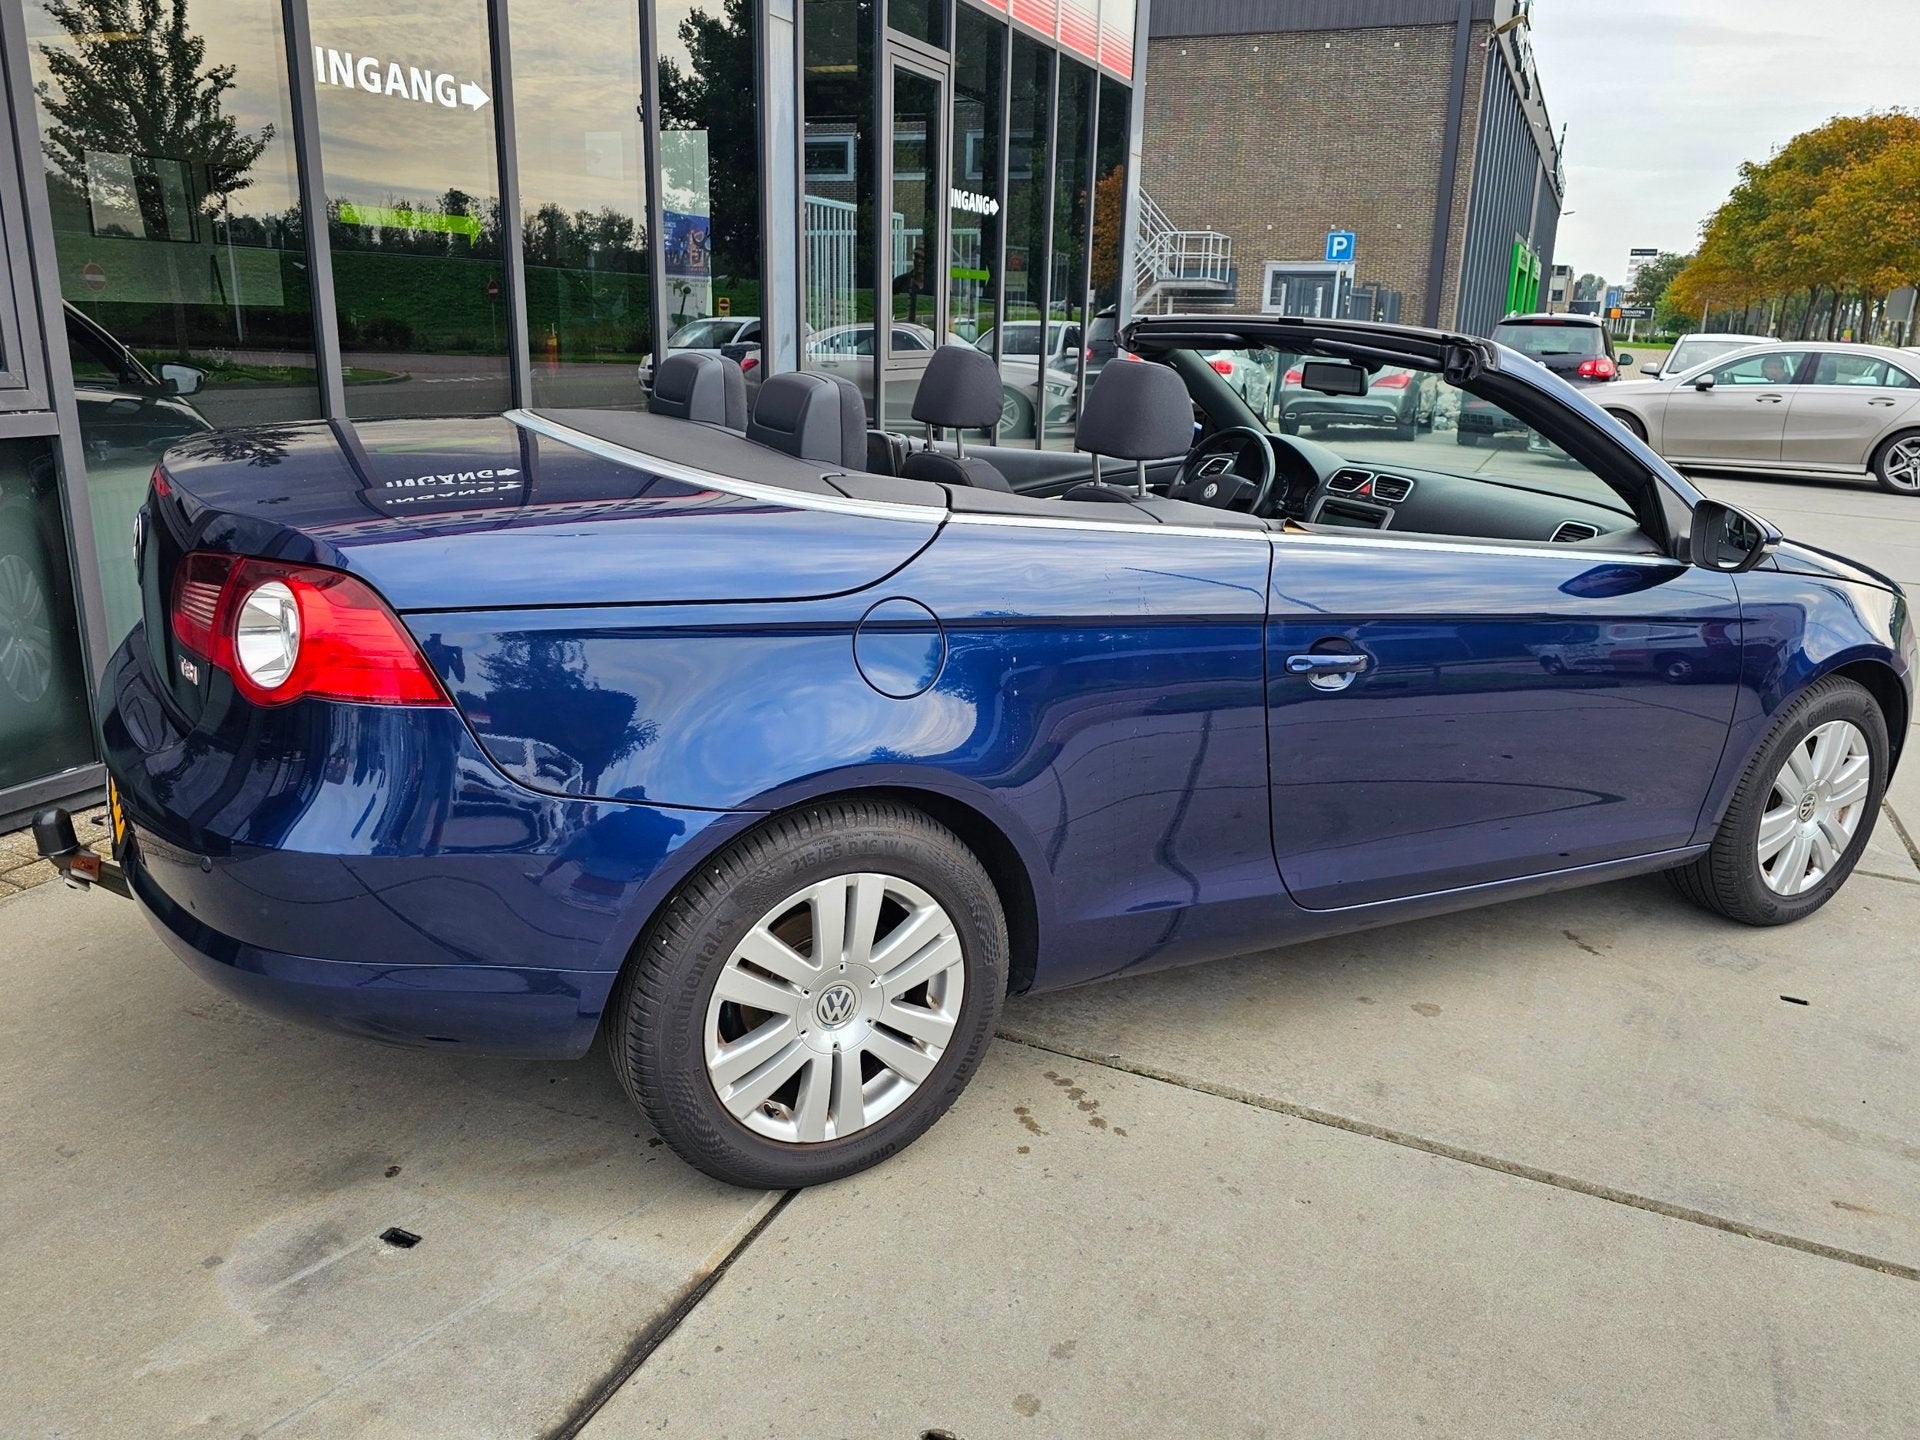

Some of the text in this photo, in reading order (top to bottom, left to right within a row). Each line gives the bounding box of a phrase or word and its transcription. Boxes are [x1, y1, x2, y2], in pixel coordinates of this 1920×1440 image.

[315, 45, 457, 108] INGANG
[951, 187, 990, 215] INGANG
[1332, 236, 1348, 258] P
[667, 931, 724, 1059] Continental
[953, 972, 999, 1082] Continental
